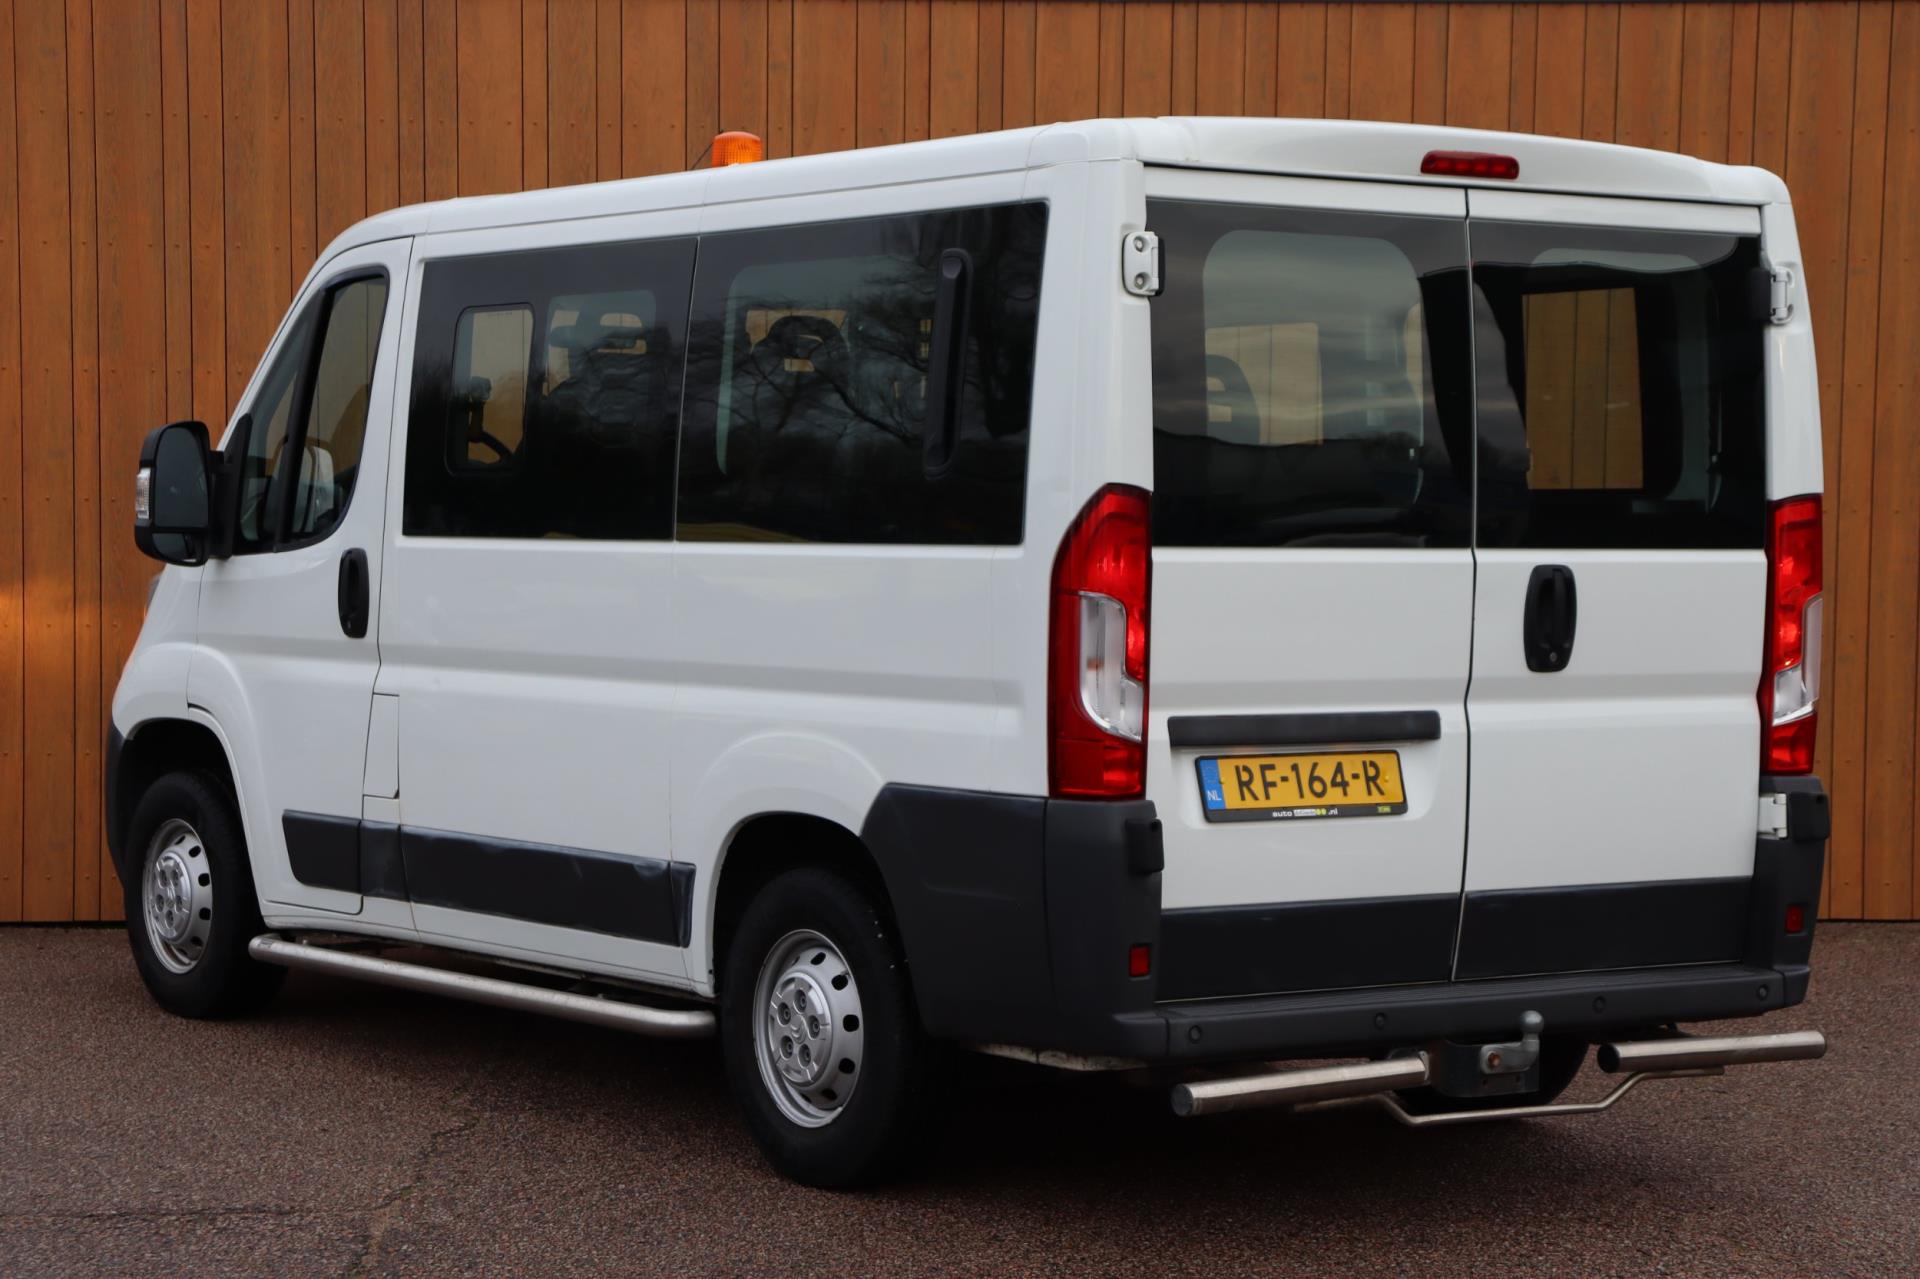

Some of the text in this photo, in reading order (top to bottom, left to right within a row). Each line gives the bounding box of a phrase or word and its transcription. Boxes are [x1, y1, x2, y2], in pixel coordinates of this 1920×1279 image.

[1234, 760, 1385, 801] RF-164-R
[1207, 790, 1222, 801] NL
[1272, 810, 1293, 818] auto
